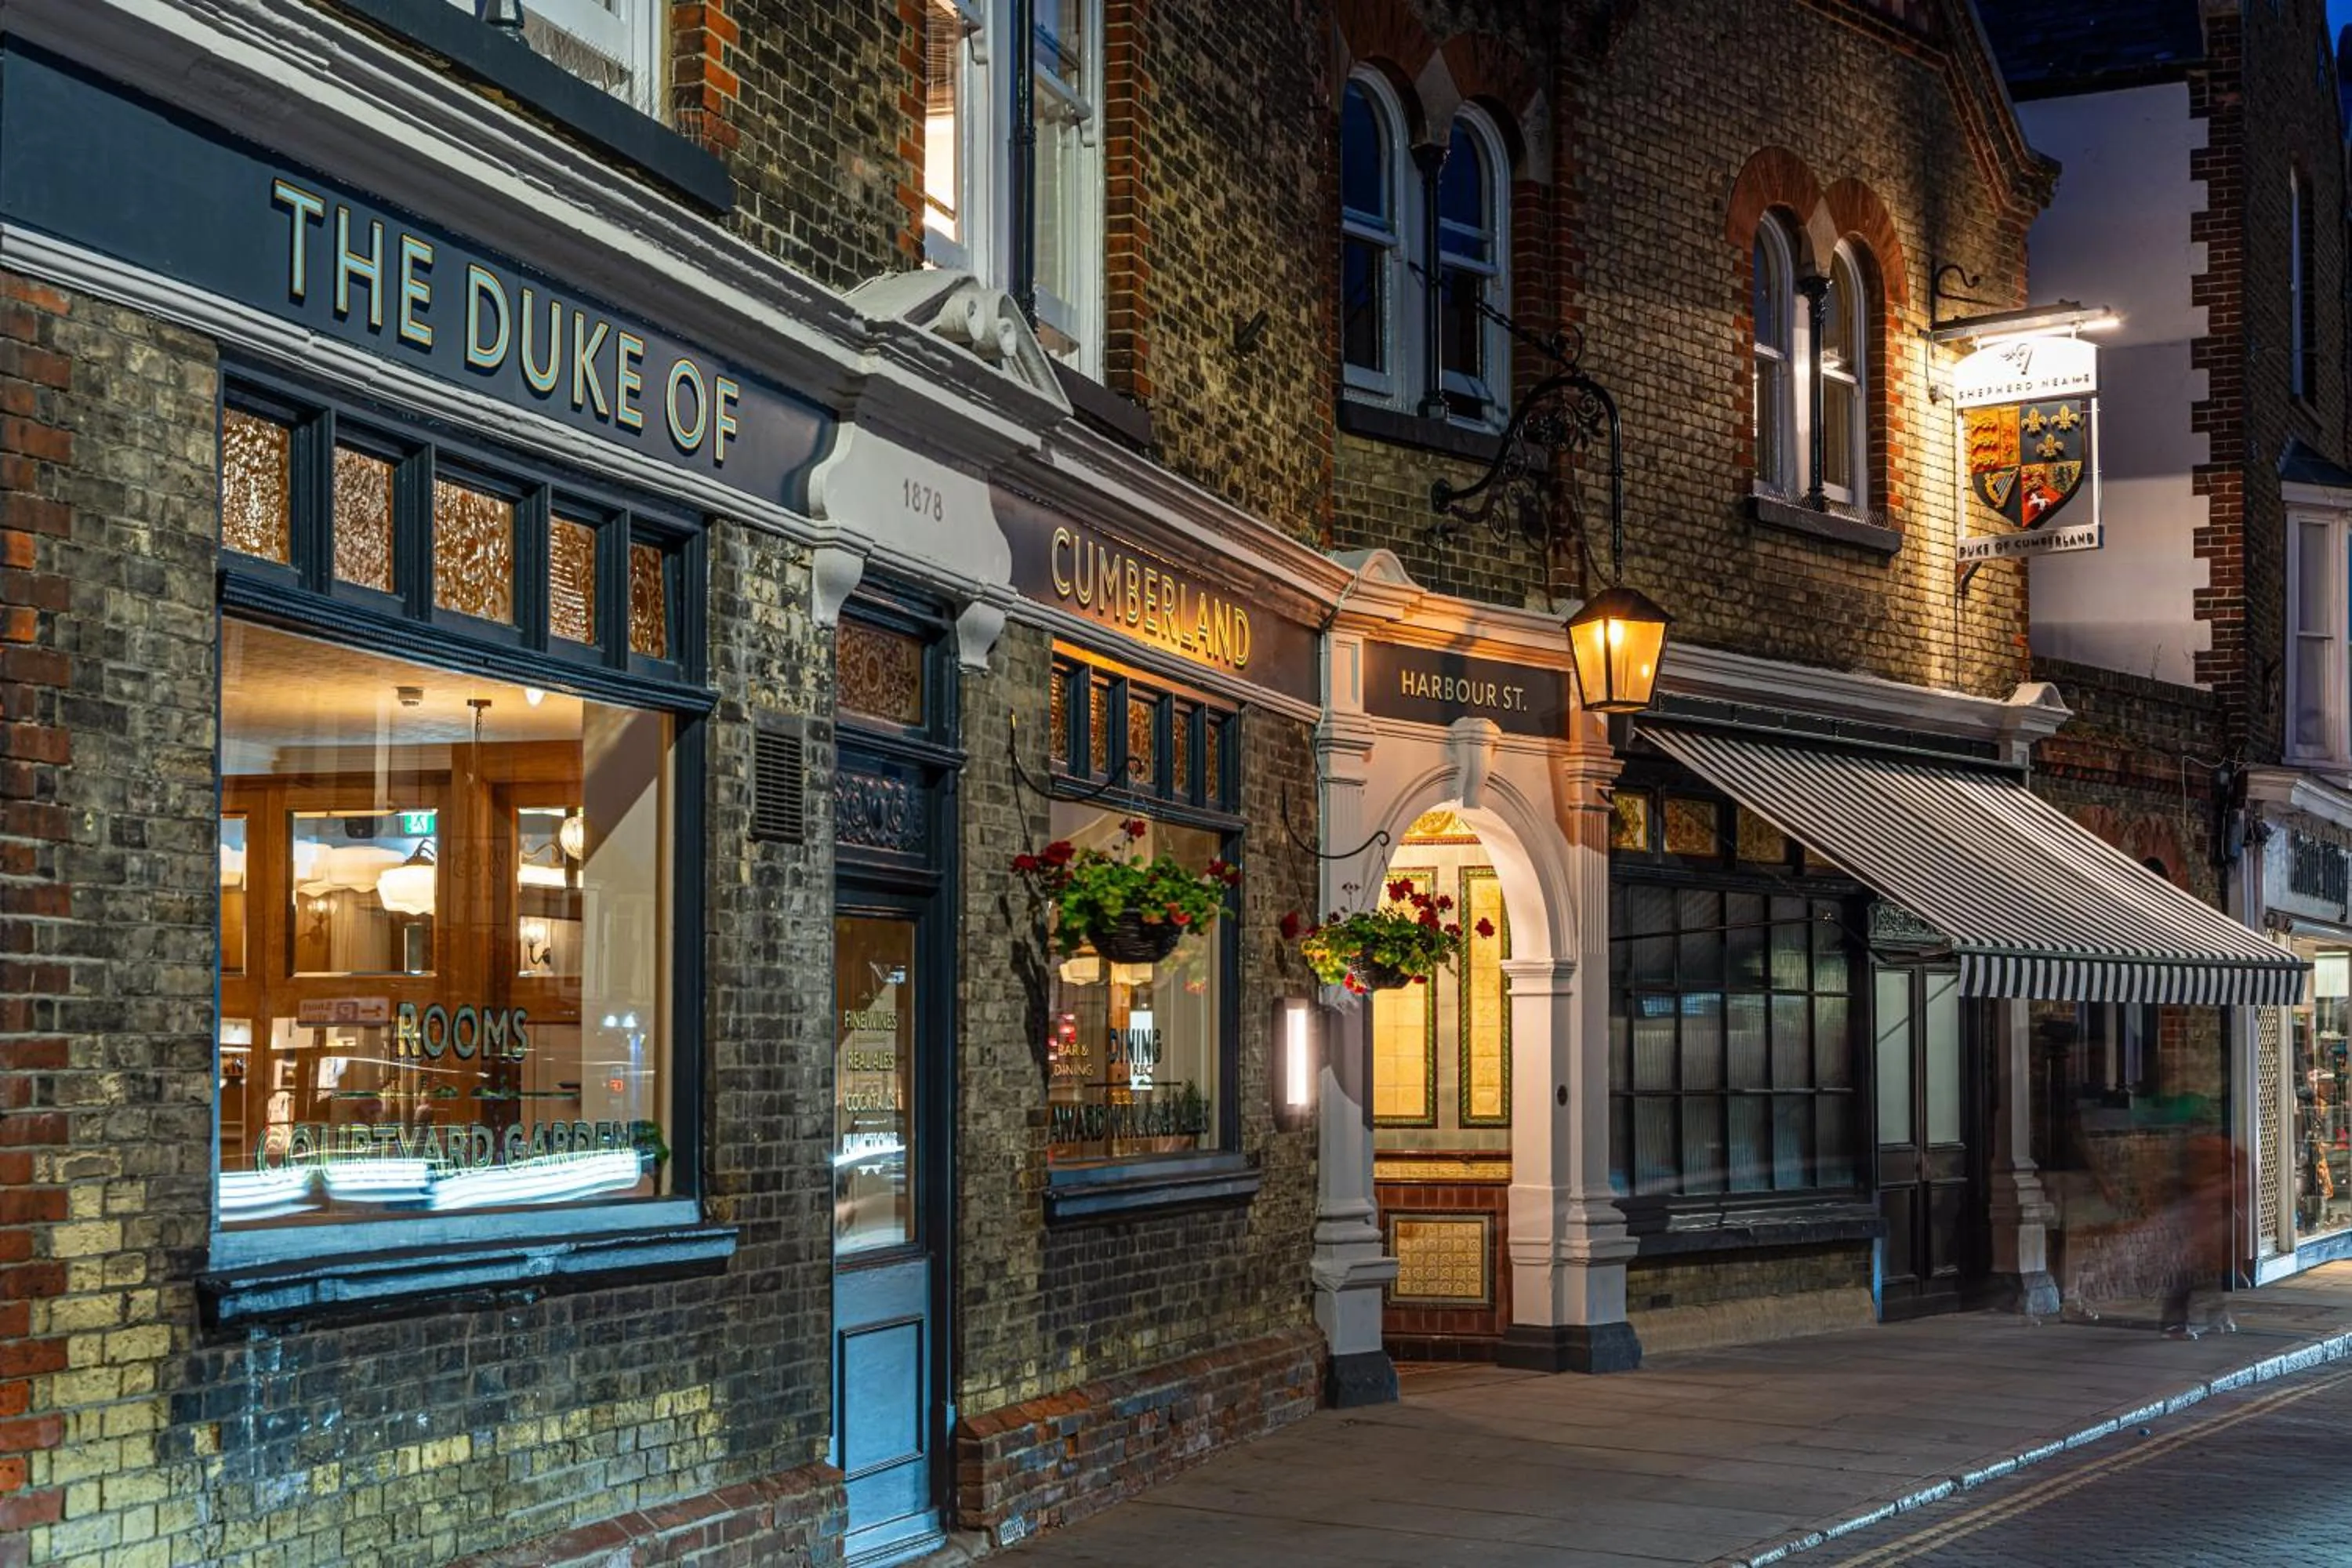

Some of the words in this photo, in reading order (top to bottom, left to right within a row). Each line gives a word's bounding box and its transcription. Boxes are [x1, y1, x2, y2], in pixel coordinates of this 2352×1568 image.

[274, 177, 434, 347] THE
[466, 262, 644, 429] DUKE
[666, 358, 739, 463] OF
[1959, 382, 2033, 401] SHEPHERD
[902, 477, 943, 522] 1878
[1959, 543, 1989, 559] DUKE
[1995, 540, 2009, 554] OF
[2014, 532, 2095, 549] CUMBERLAND
[1051, 526, 1251, 667] CUMBERLAND
[1400, 669, 1497, 707] HARBOUR
[1503, 685, 1527, 712] ST.
[397, 1002, 528, 1062] ROOMS
[844, 1010, 866, 1029] FINE
[873, 1051, 895, 1070] ALES
[1058, 1044, 1079, 1056] BAR
[1108, 1028, 1163, 1064] DINING
[1053, 1063, 1094, 1077] DINING
[255, 1121, 495, 1178] COURTYARD
[503, 1120, 635, 1170] GARDEN
